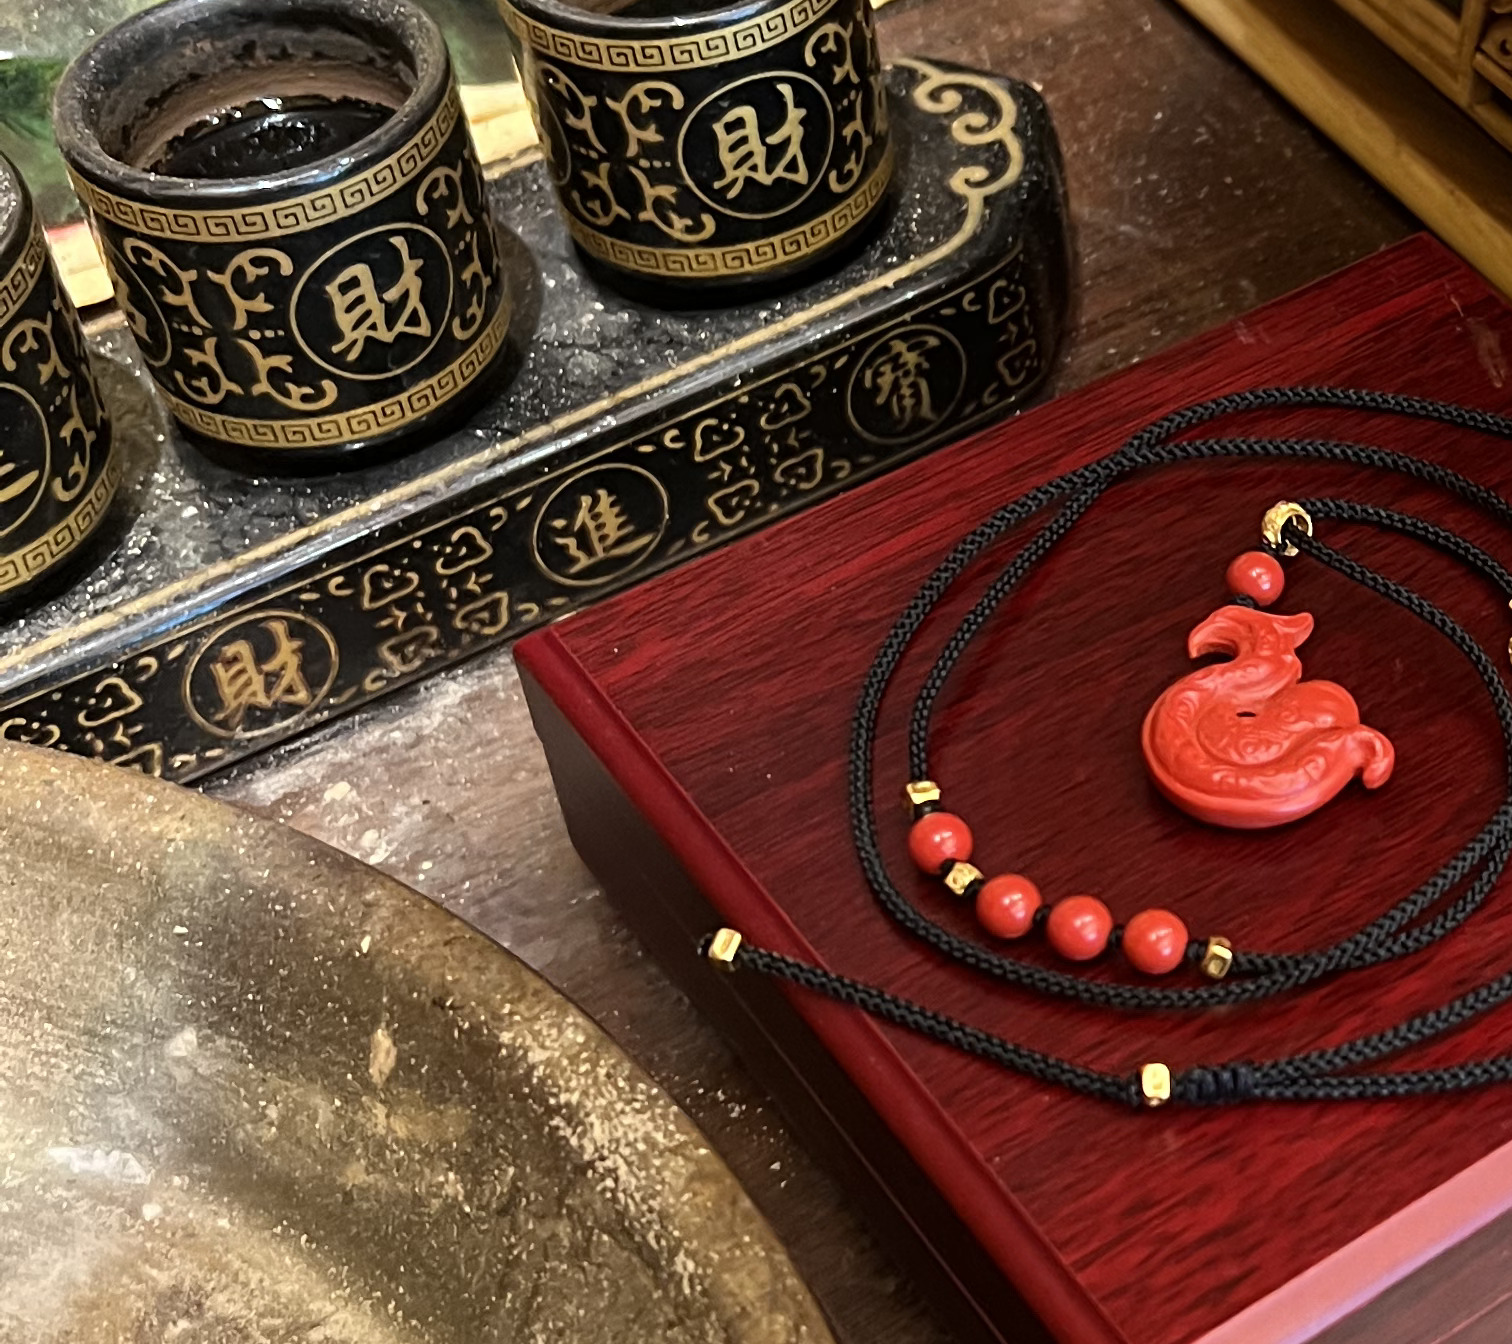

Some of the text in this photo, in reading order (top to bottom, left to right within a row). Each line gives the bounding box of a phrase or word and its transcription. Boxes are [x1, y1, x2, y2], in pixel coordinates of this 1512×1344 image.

[711, 83, 809, 199] 財
[326, 235, 432, 361] 財
[209, 621, 313, 728] 財
[548, 488, 660, 574] 進
